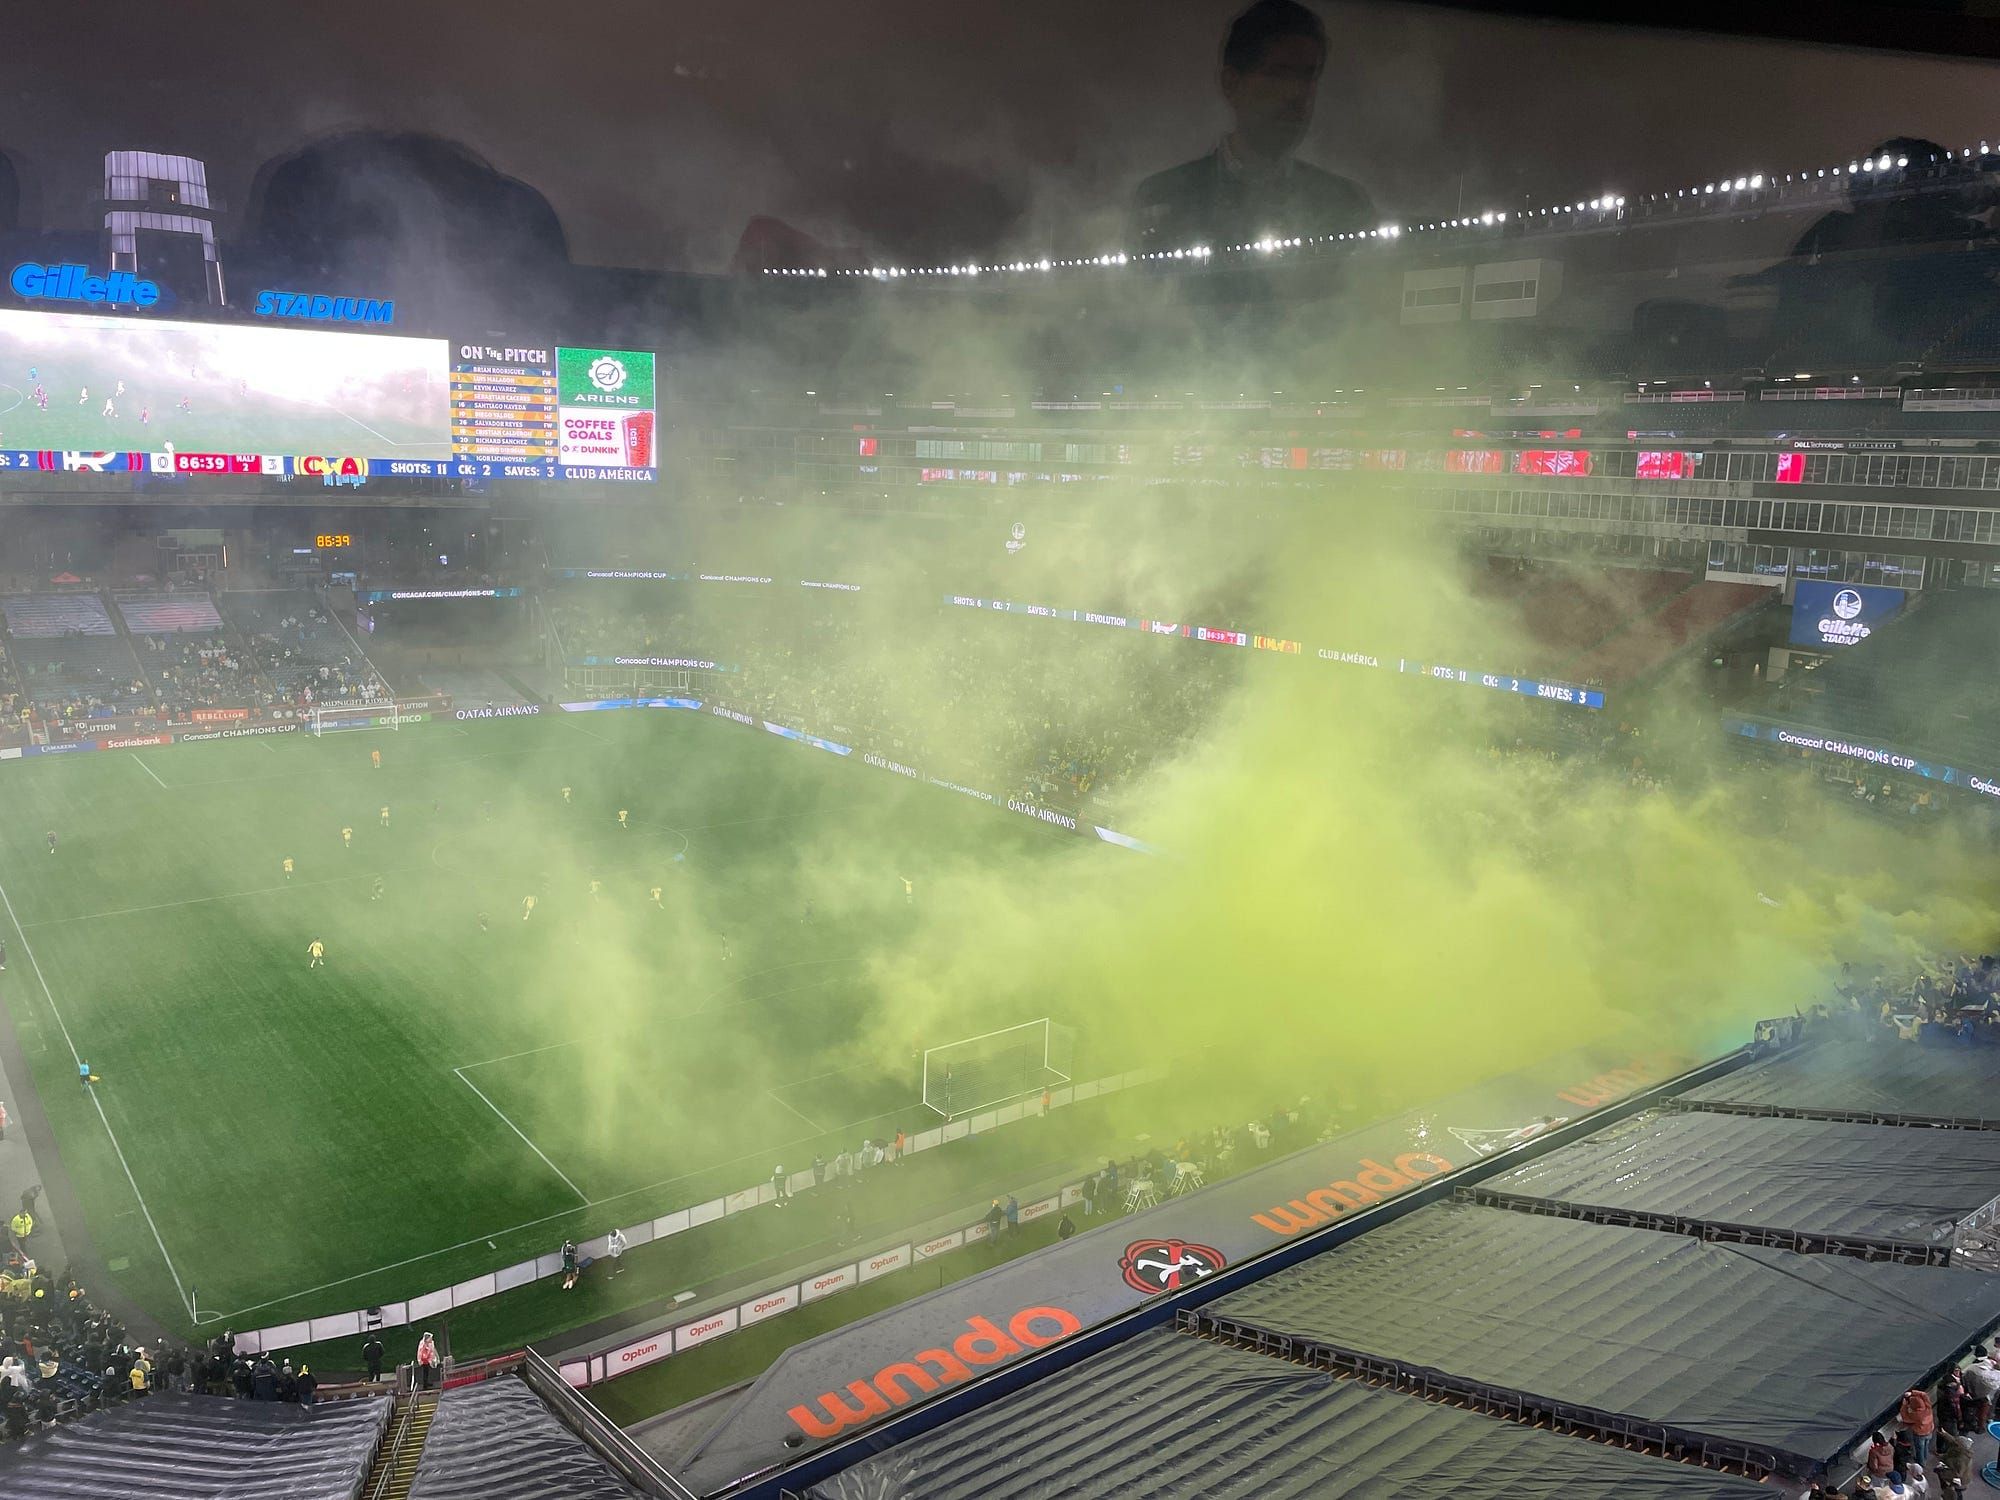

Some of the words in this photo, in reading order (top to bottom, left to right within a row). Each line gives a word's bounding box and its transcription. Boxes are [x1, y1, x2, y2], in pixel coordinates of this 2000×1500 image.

[11, 262, 158, 306] Gillette
[254, 290, 394, 324] STADIUM
[461, 345, 483, 360] ON
[504, 348, 547, 364] PITCH
[574, 393, 640, 404] ARIENS
[564, 419, 616, 430] COFFEE
[568, 430, 613, 441] GOALS
[19, 453, 30, 467] 2
[157, 456, 169, 469] 0
[179, 456, 225, 470] 86:39
[243, 463, 249, 471] 2
[391, 463, 431, 475] SHOTS:
[457, 464, 476, 476] CK:
[482, 465, 491, 476] 2
[504, 465, 540, 477] SAVES:
[547, 466, 555, 478] 3
[565, 468, 597, 479] CLUB
[598, 467, 653, 481] AMÉRICA
[317, 535, 350, 547] 86:39
[724, 575, 759, 583] CHAMPIONS
[953, 596, 975, 607] SHOTS:
[992, 601, 1002, 610] CK:
[1027, 605, 1048, 616] SAVES:
[1052, 609, 1056, 617] 2
[1085, 612, 1126, 627] REVOLUTION
[1818, 619, 1871, 638] Gillette
[650, 658, 698, 667] CHAMPIONS
[699, 661, 714, 669] CUP
[1318, 648, 1339, 660] CLUB
[1340, 652, 1378, 667] AMÉRICA
[1482, 674, 1498, 688] CK:
[1511, 679, 1519, 692] 2
[1537, 684, 1573, 702] SAVES:
[1578, 691, 1586, 704] 3
[456, 708, 493, 720] QATAR
[494, 705, 539, 717] AIRWAYS
[712, 705, 731, 718] QATAR
[379, 714, 422, 725] aramco
[184, 732, 221, 741] Concacaf
[222, 726, 277, 738] CHAMPIONS
[278, 724, 296, 732] CUP
[107, 736, 161, 749] Scotiabank
[1778, 731, 1823, 749] Concacaf
[1824, 740, 1889, 765] CHAMPIONS
[1891, 755, 1915, 770] CUP
[864, 753, 886, 769] QATAR
[887, 760, 917, 778] AIRWAYS
[980, 792, 992, 801] CUP
[1007, 798, 1036, 817] QATAR
[1037, 808, 1076, 830] AIRWAYS
[1024, 1202, 1049, 1217] Optum
[924, 1237, 952, 1254] Optum
[870, 1254, 899, 1270] Optum
[814, 1272, 844, 1291] Optum
[754, 1295, 786, 1313] Optum
[689, 1318, 724, 1337] Optum
[621, 1343, 658, 1362] Optum
